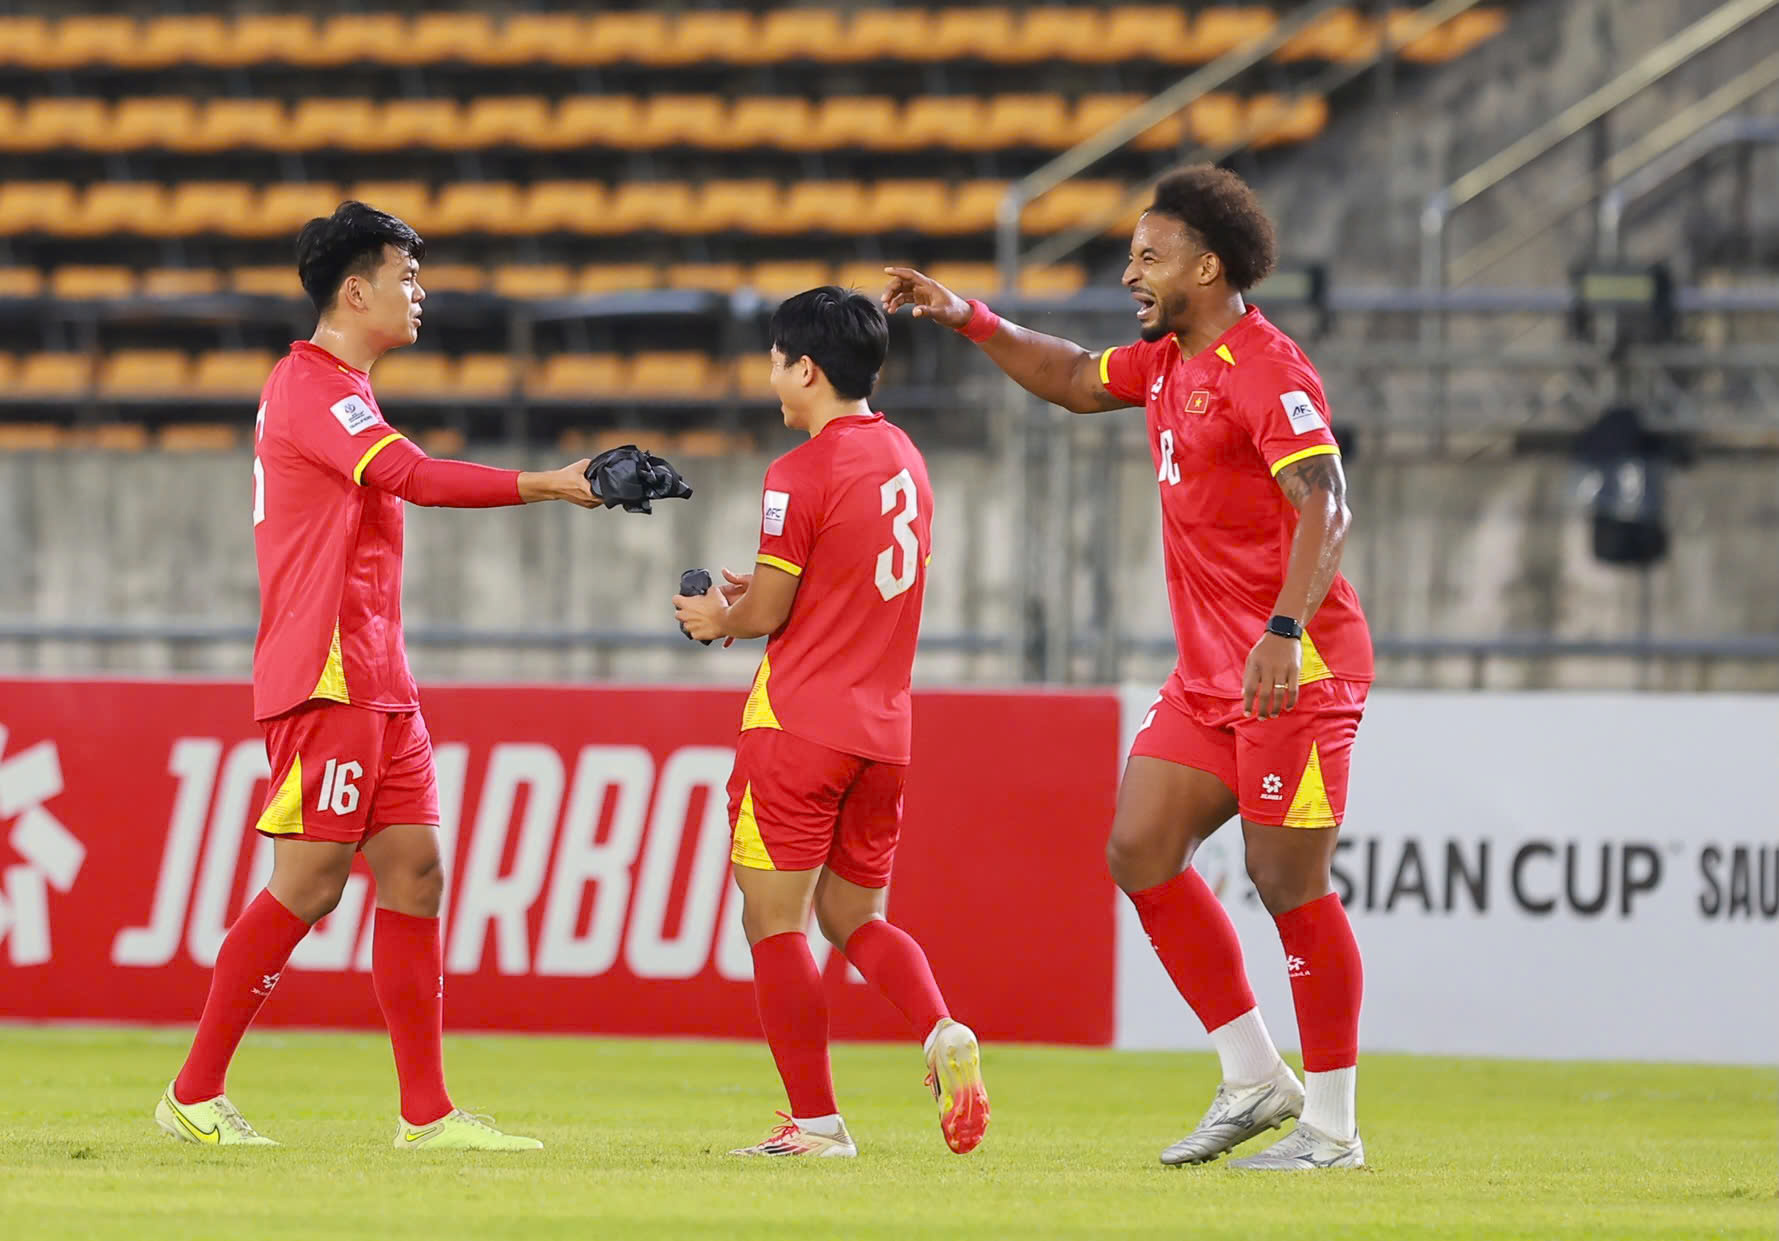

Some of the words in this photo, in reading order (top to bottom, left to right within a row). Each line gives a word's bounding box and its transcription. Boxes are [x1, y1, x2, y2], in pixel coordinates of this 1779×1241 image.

[765, 507, 783, 519] AFC
[874, 468, 919, 602] 3
[316, 757, 364, 816] 16
[111, 737, 868, 984] JORBO
[1328, 837, 1490, 915] SIAN
[1509, 838, 1664, 918] CUP
[1697, 843, 1779, 921] SAU
